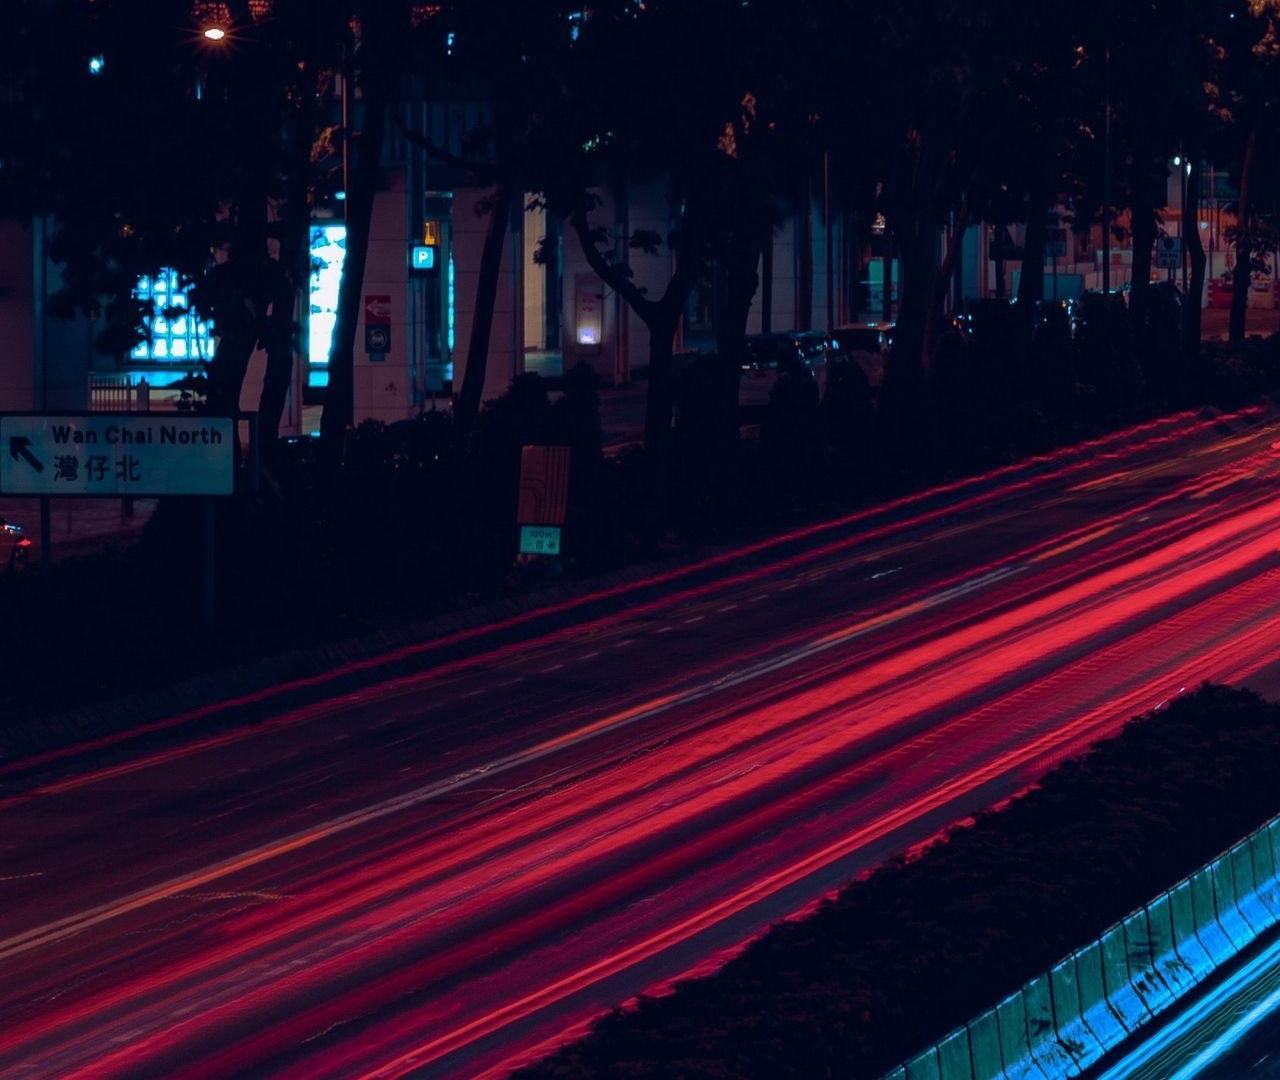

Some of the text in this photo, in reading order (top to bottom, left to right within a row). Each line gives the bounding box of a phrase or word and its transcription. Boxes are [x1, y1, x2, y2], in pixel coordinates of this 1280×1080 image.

[418, 251, 429, 264] P
[53, 425, 222, 445] Wan Chai North
[53, 455, 141, 482] 灣仔北
